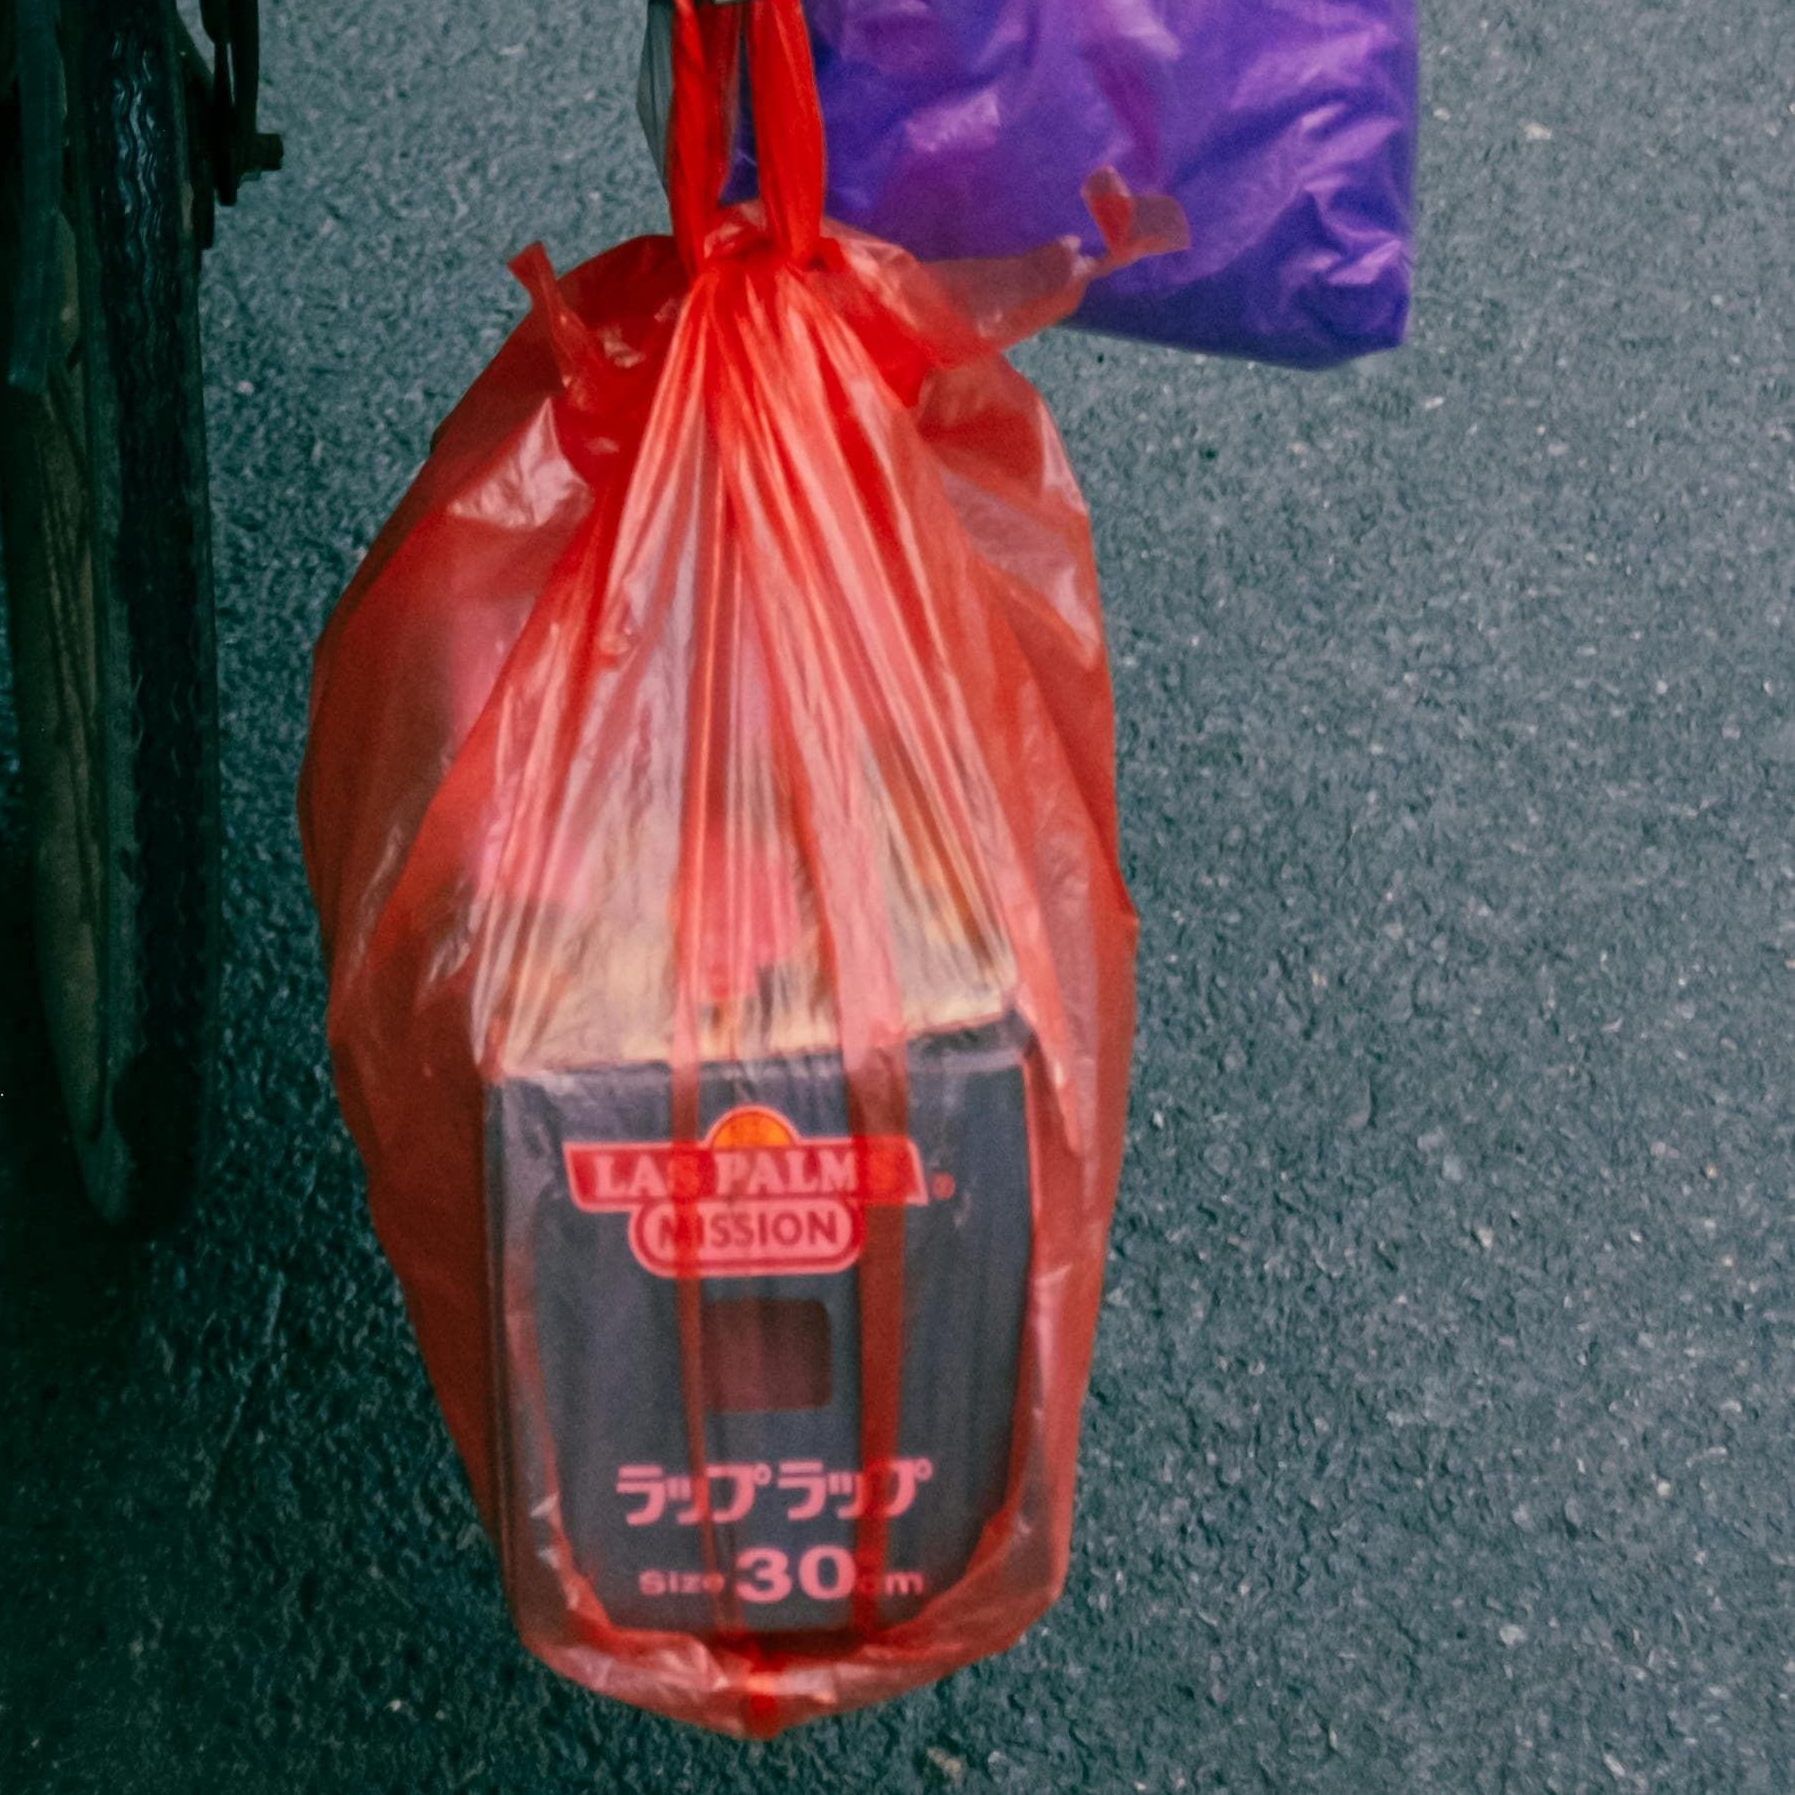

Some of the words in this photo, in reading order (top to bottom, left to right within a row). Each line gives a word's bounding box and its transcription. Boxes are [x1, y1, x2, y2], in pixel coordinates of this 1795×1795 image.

[594, 1153, 703, 1198] LAS
[658, 1209, 839, 1251] MISSION
[615, 1456, 934, 1527] ラップラップ
[638, 1569, 726, 1597] Size
